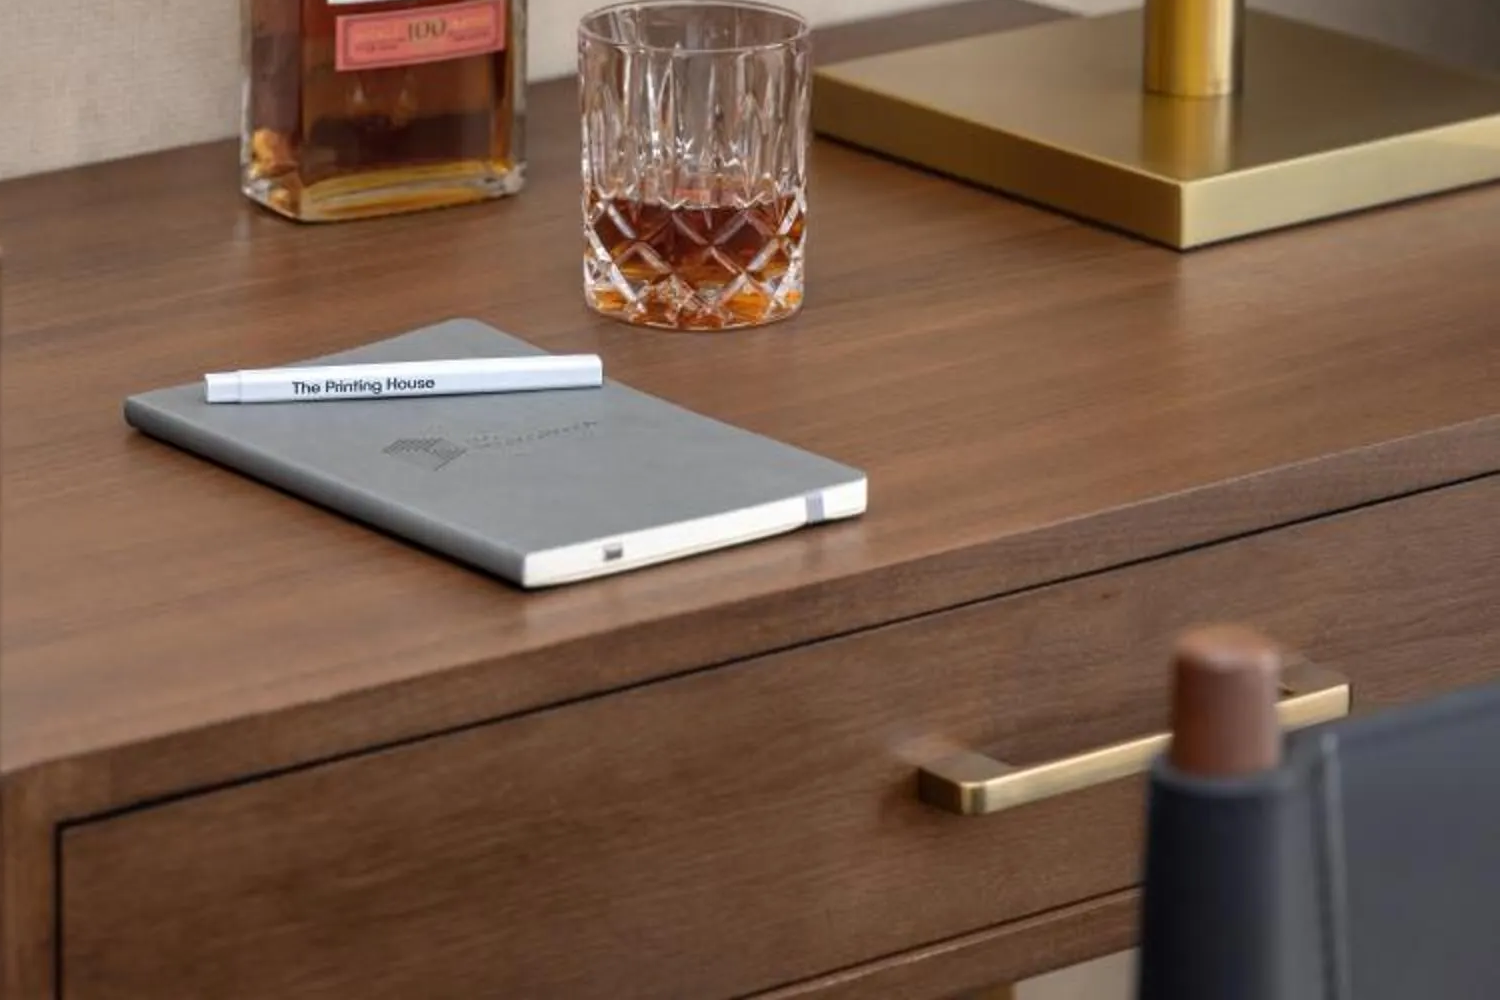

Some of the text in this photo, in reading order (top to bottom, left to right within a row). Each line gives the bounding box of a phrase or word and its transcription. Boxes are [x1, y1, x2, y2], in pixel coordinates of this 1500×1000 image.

[292, 377, 436, 395] The Printing House
